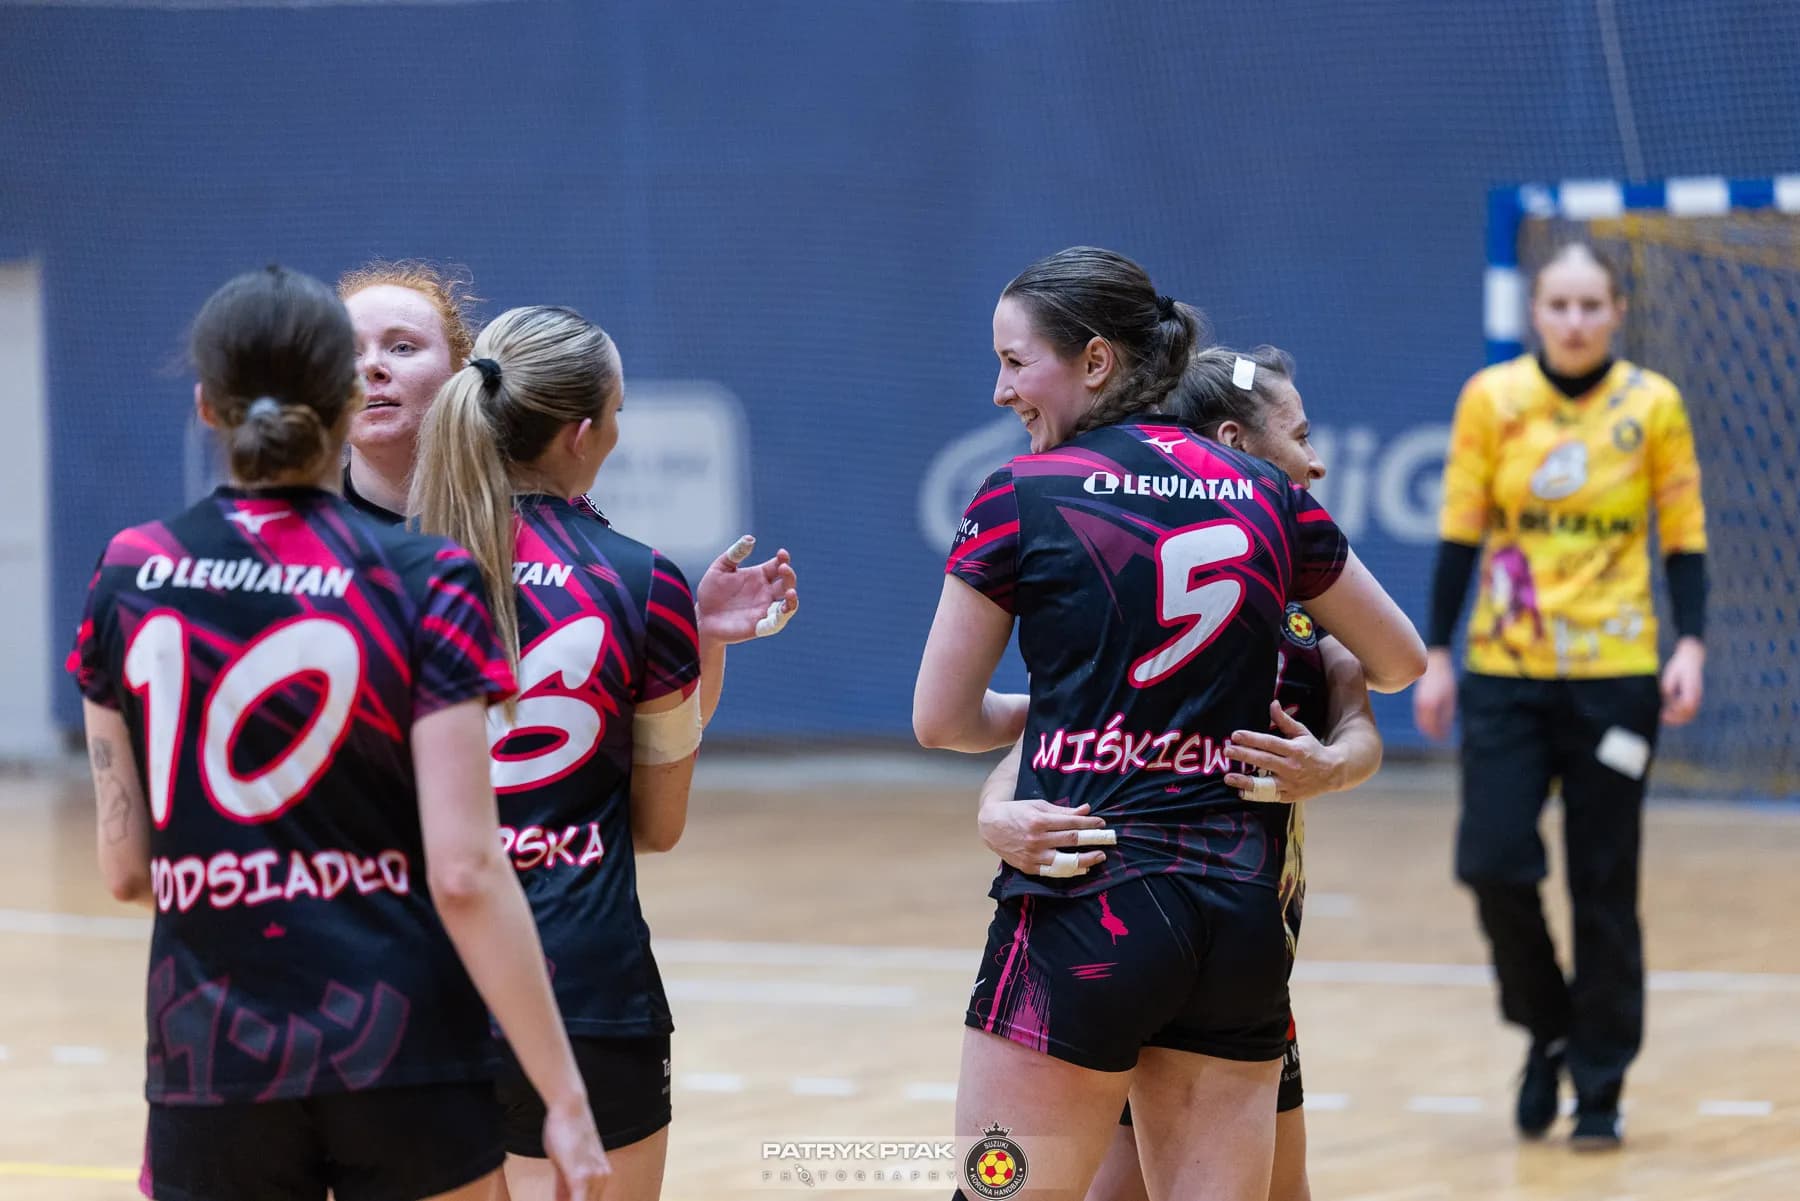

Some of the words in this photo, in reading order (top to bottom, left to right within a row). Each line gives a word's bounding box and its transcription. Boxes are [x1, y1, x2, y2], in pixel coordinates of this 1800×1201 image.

[1123, 474, 1254, 500] LEWIATAN
[171, 556, 354, 598] LEWIATAN
[1128, 518, 1255, 689] 5
[124, 608, 364, 828] 10
[1032, 712, 1257, 775] MIŚKIEW
